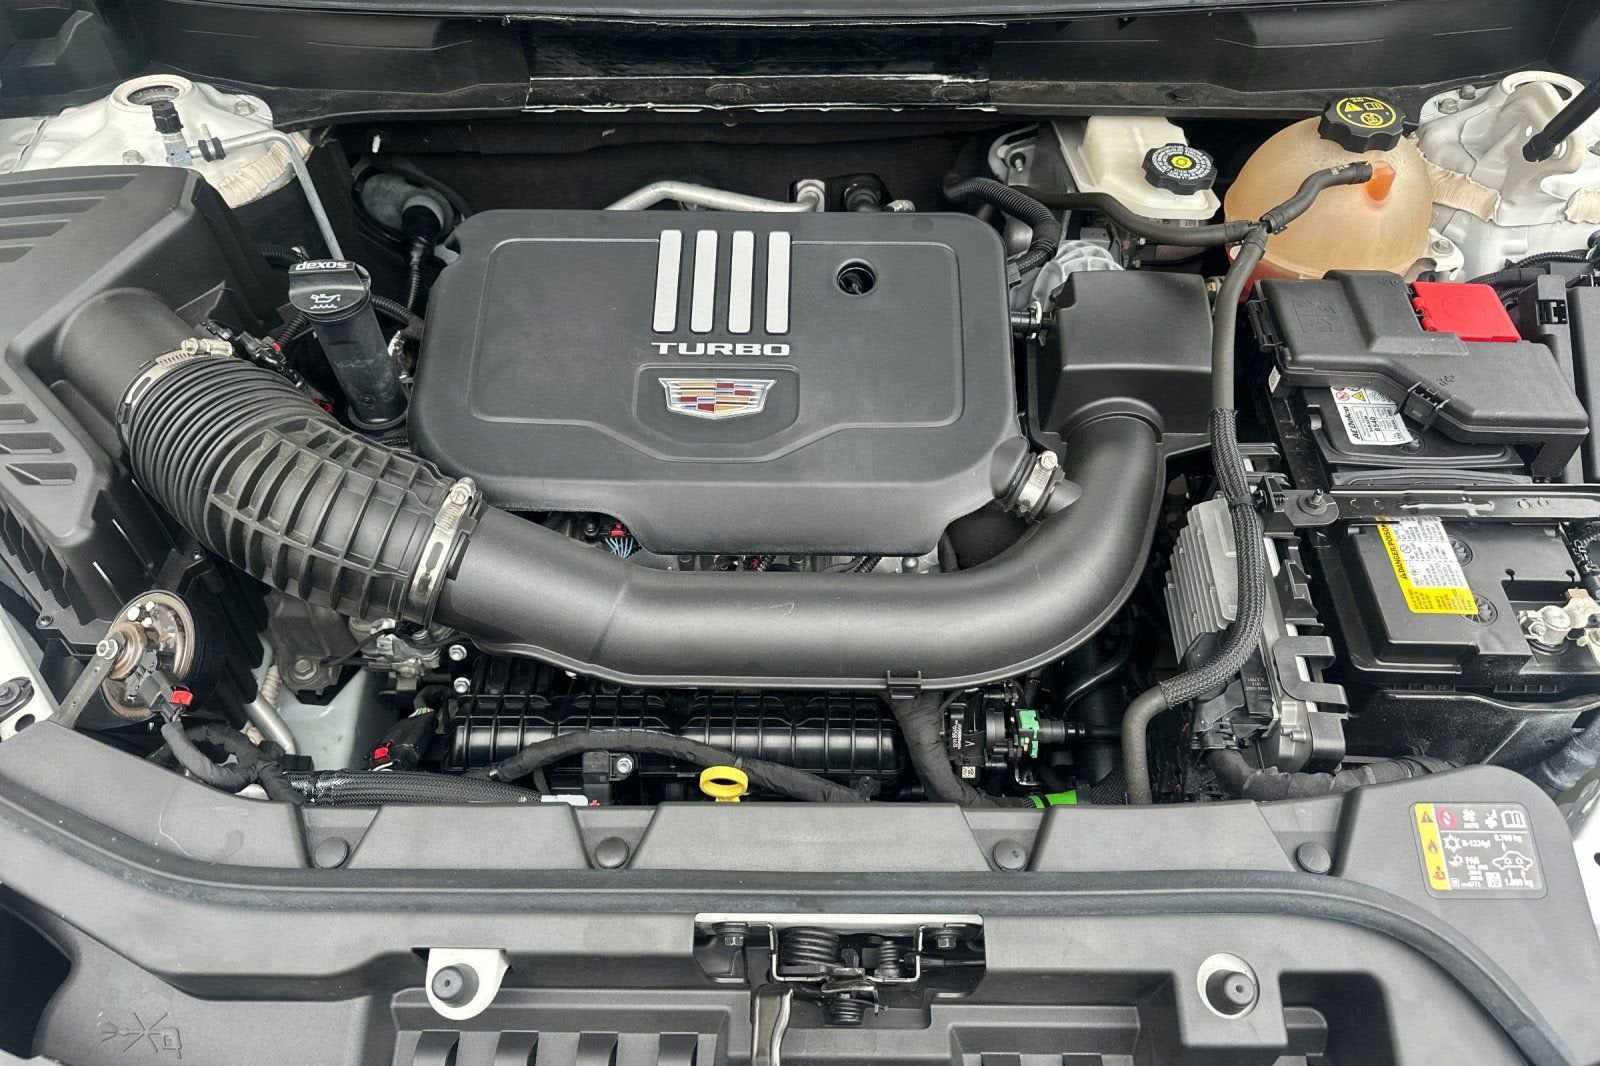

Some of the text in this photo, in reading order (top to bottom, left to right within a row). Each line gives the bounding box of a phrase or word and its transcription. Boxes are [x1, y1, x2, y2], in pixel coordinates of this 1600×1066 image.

[296, 261, 350, 271] dexos
[651, 342, 790, 356] TURBO
[1343, 405, 1361, 440] ACDelco
